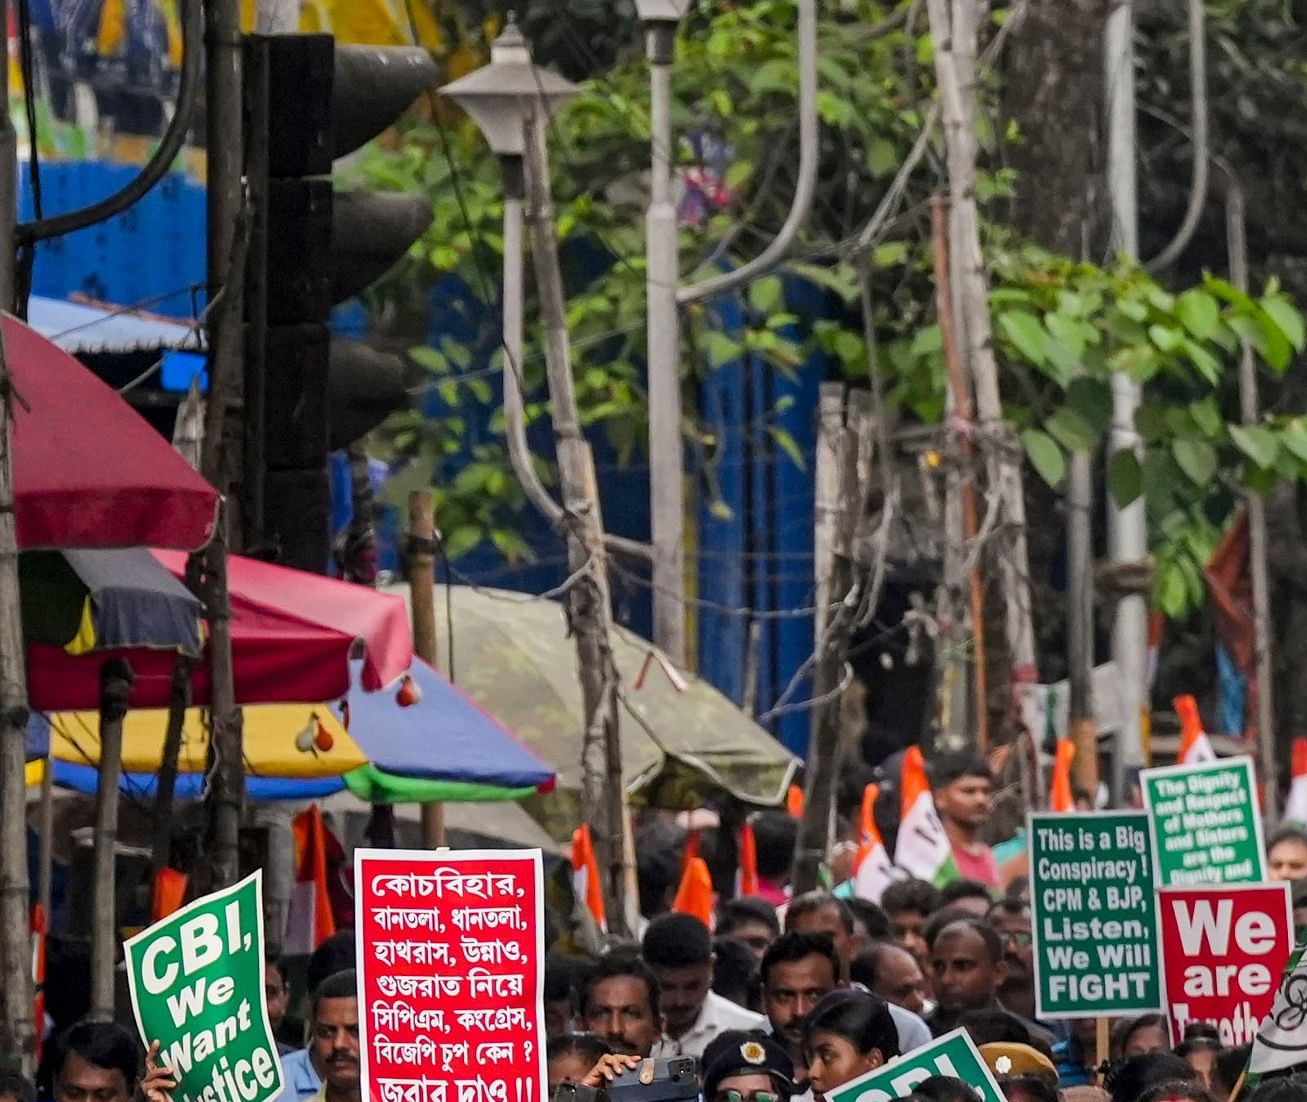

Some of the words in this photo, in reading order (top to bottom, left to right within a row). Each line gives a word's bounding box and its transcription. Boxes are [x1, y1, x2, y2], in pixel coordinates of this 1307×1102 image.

[1038, 828, 1074, 851] This
[1078, 829, 1095, 850] is
[1100, 833, 1111, 850] a
[1116, 826, 1146, 852] Big
[371, 867, 526, 899] কোচবিহার,
[1038, 857, 1137, 885] Conspiracy
[1043, 888, 1082, 912] CPM
[1088, 888, 1102, 909] &
[1107, 886, 1147, 912] BJP,
[371, 906, 447, 933] বানতলা,
[451, 906, 528, 931] ধানতলা,
[1044, 919, 1149, 941] Listen,
[1172, 899, 1277, 956] We
[141, 900, 252, 995] CBI,
[372, 939, 457, 967] হাথরাস,
[460, 934, 529, 965] উন্নাও,
[1047, 948, 1089, 970] We
[1097, 945, 1150, 967] Will
[376, 973, 463, 999] গুজরাত
[467, 967, 524, 998] নিয়ে
[1049, 972, 1151, 1002] FIGHT
[1183, 962, 1272, 998] are
[166, 976, 235, 1028] We
[371, 1000, 451, 1034] সিপিএম,
[454, 1005, 533, 1032] কংগ্রেস,
[160, 998, 252, 1084] Want
[373, 1033, 436, 1065] বিজেপি
[439, 1040, 469, 1073] চুপ
[475, 1042, 514, 1065] কেন
